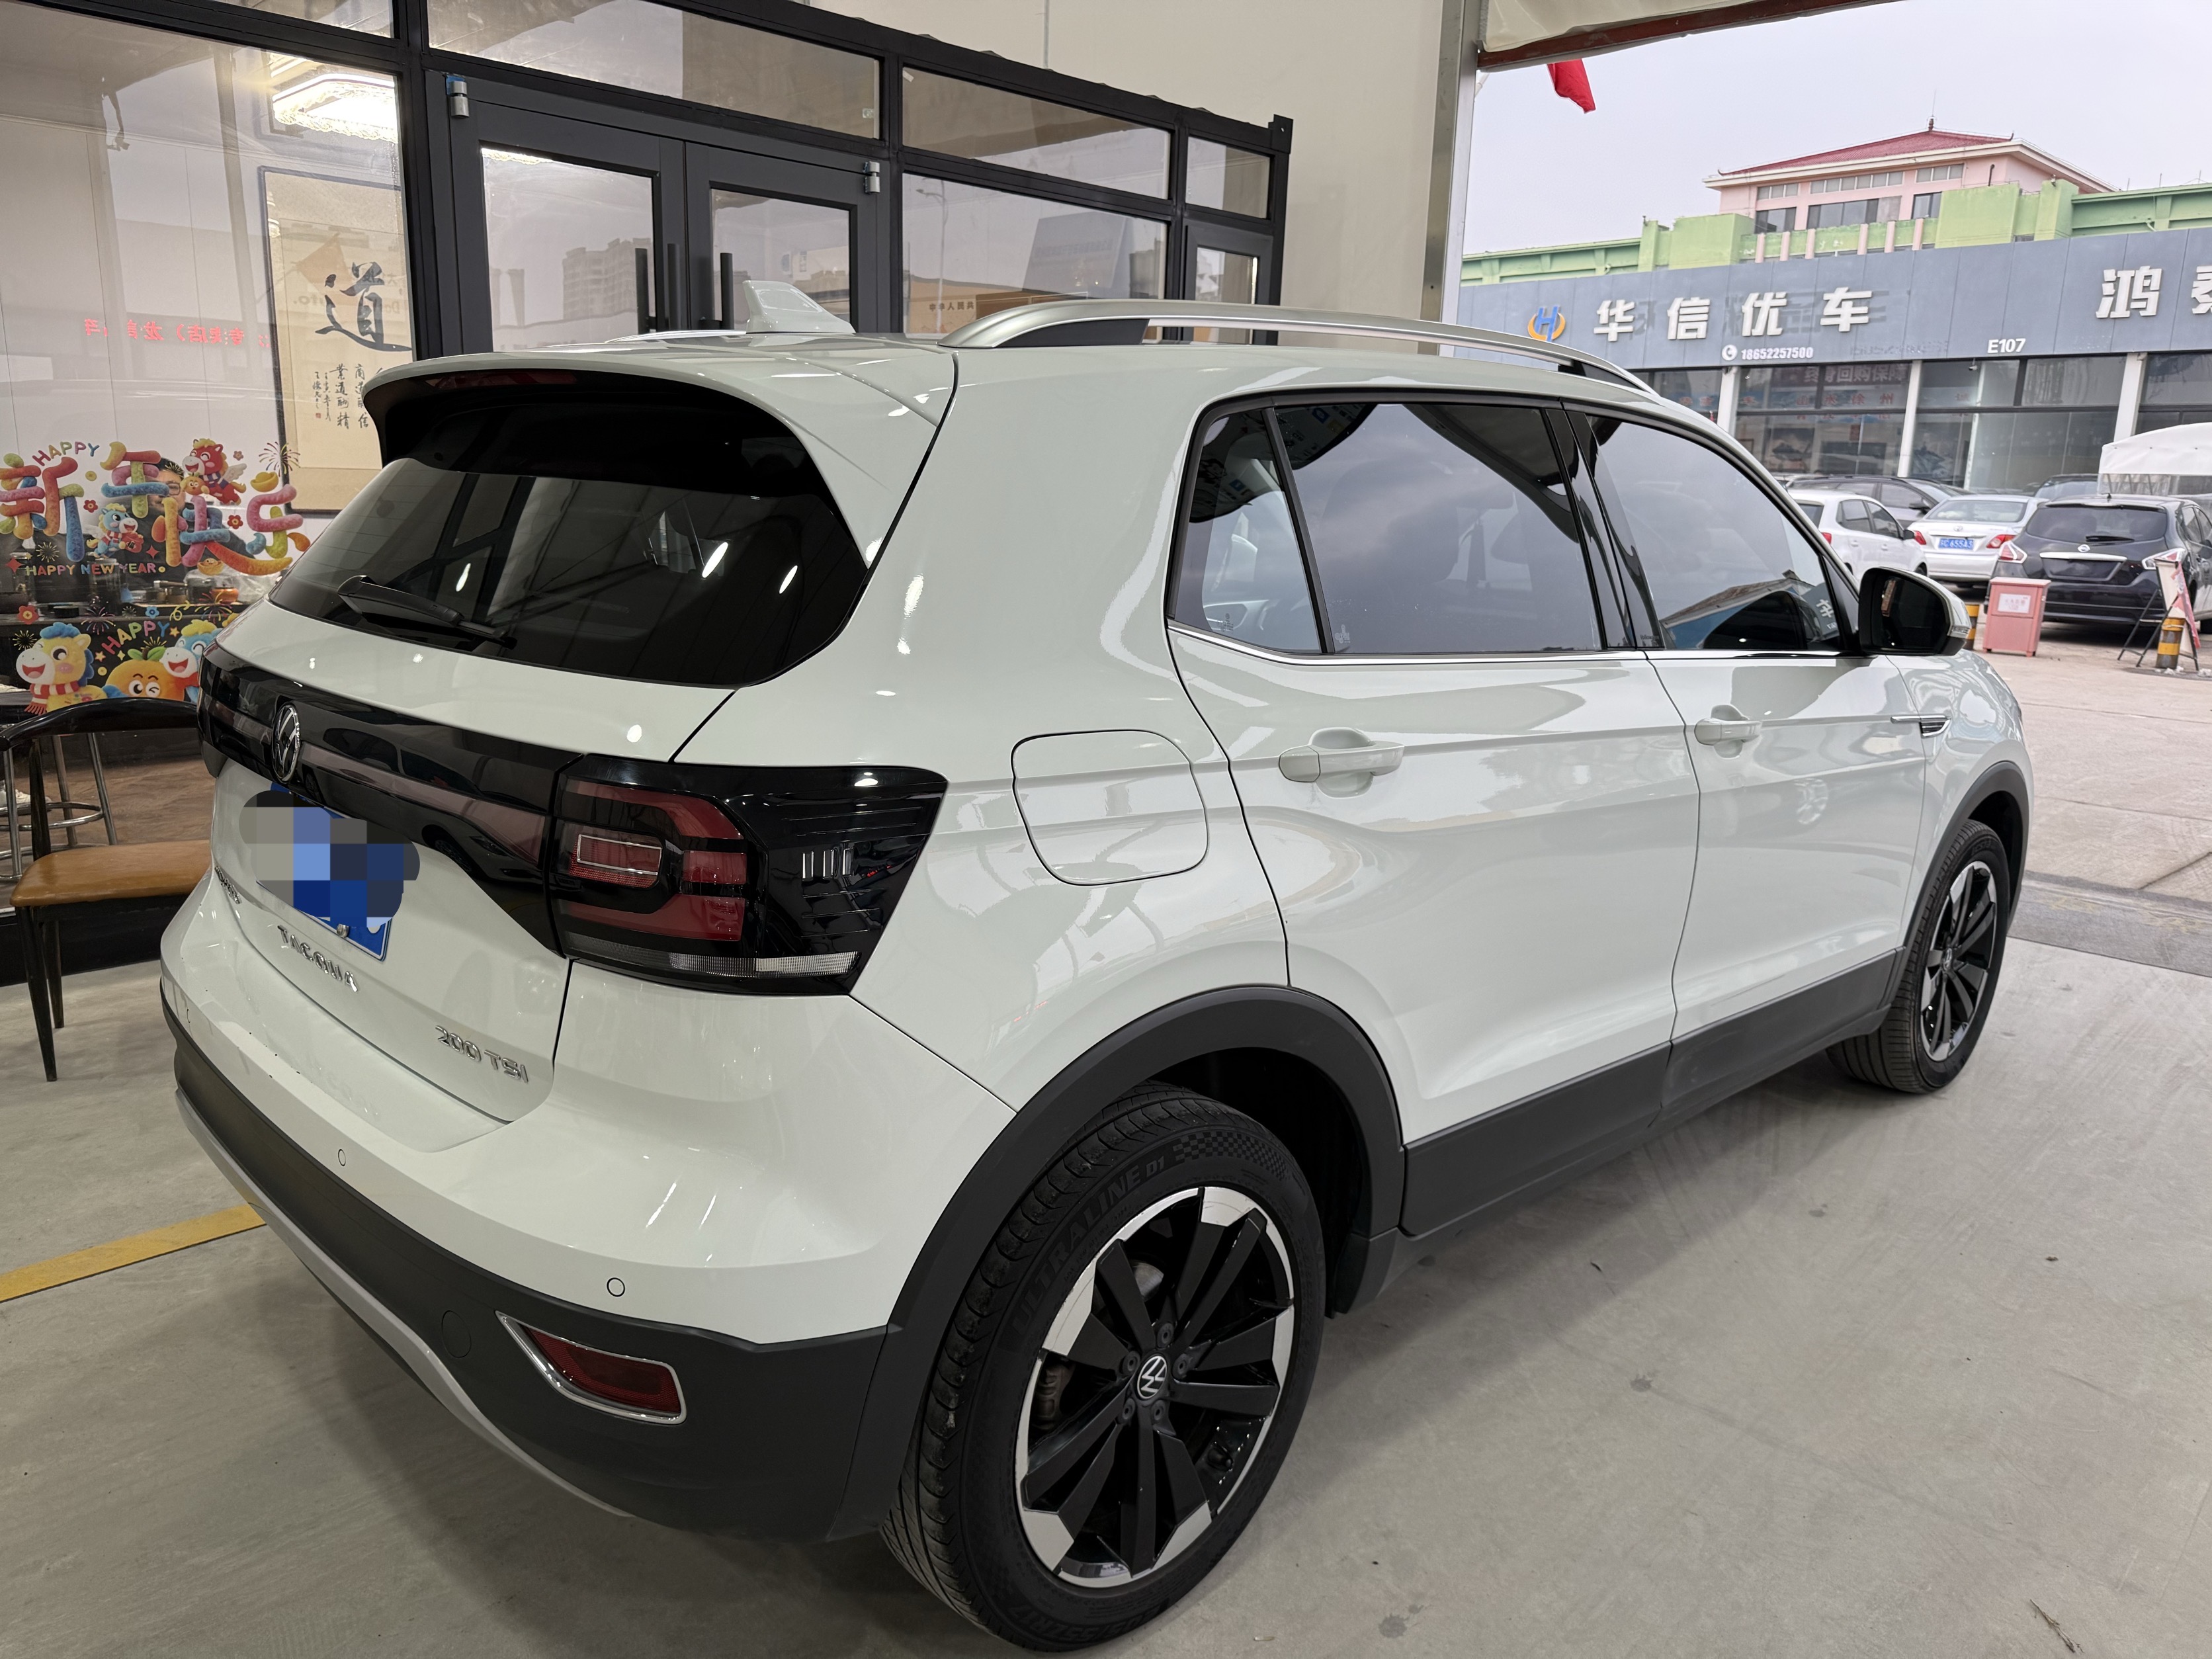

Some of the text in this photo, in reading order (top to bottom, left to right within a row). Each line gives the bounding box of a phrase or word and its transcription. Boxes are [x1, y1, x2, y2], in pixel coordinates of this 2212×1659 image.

[315, 261, 413, 352] 道
[1594, 286, 1873, 342] 华信优车
[1741, 347, 1814, 361] 18652257500
[1987, 338, 2026, 354] E107
[32, 441, 100, 466] HAPPY
[25, 563, 157, 576] HAPPY NEW YEAR
[101, 620, 170, 655] HAPPY
[277, 925, 359, 993] TACQUA
[435, 1025, 529, 1084] 200 TSI
[1012, 1164, 1142, 1338] ULTRALINE
